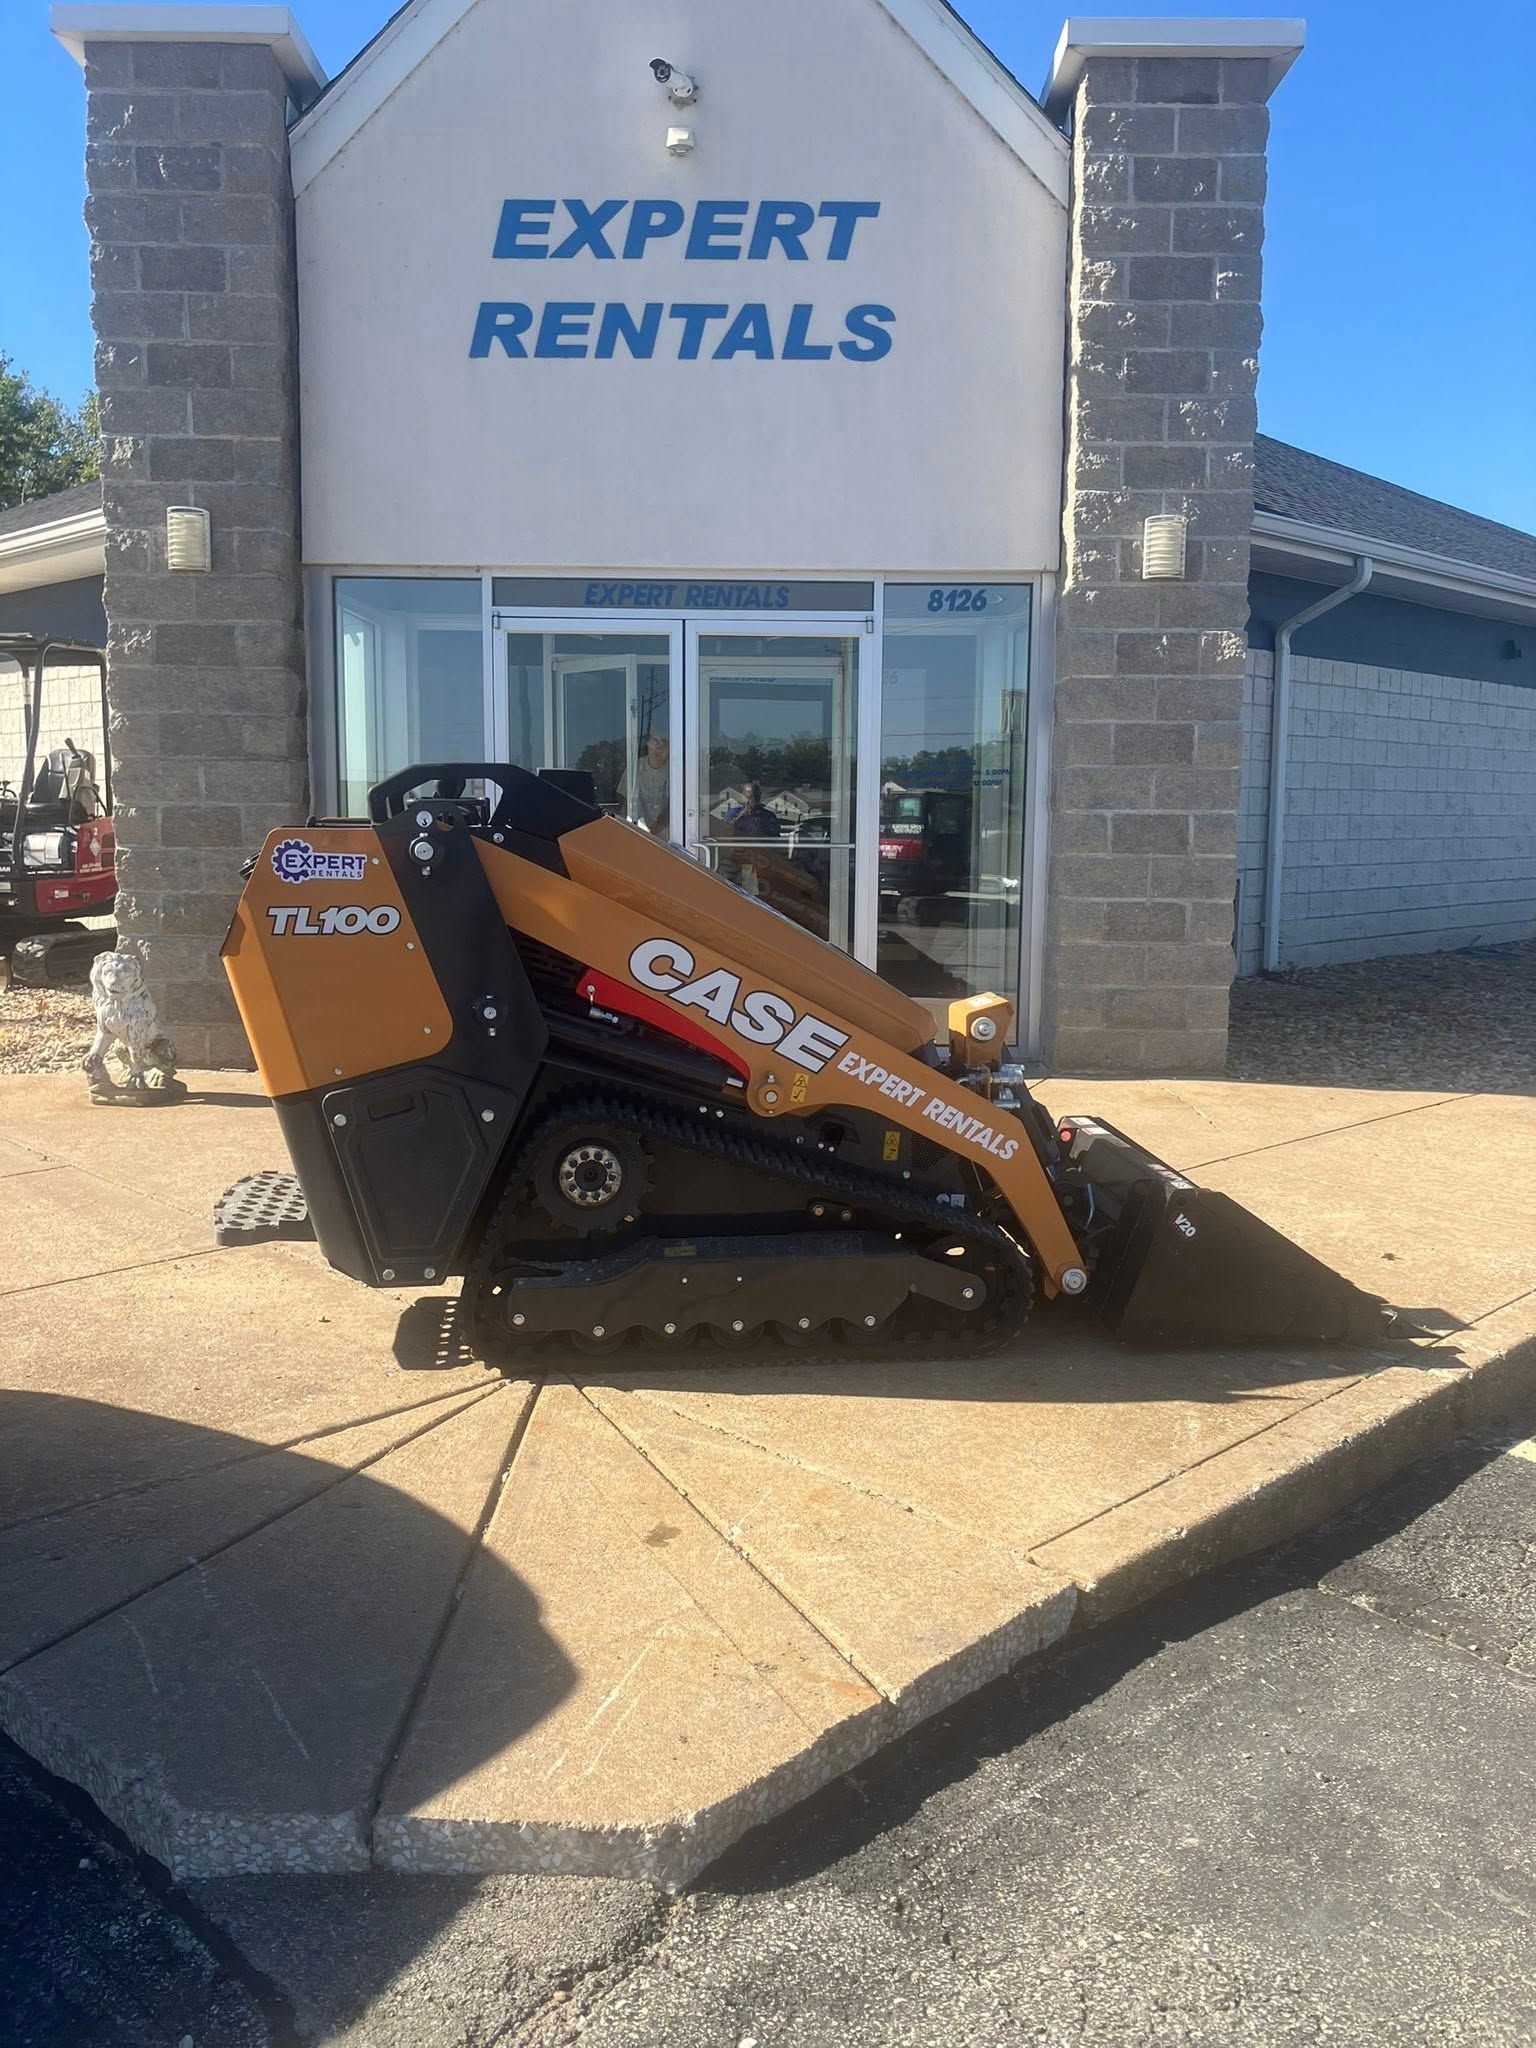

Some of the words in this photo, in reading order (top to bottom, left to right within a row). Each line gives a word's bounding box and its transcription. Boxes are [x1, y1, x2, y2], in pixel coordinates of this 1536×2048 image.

[492, 199, 881, 260] EXPERT
[469, 302, 896, 362] RENTALS
[584, 583, 675, 607] EXPERT
[684, 584, 790, 608] RENTALS
[927, 589, 987, 612] 8126
[285, 854, 366, 870] EXPERT
[311, 869, 363, 878] RENTALS
[267, 905, 401, 935] TL100
[628, 937, 852, 1075] CASE
[837, 1051, 926, 1108] EXPERT
[922, 1097, 1019, 1160] RENTALS
[1174, 1213, 1196, 1237] V20
